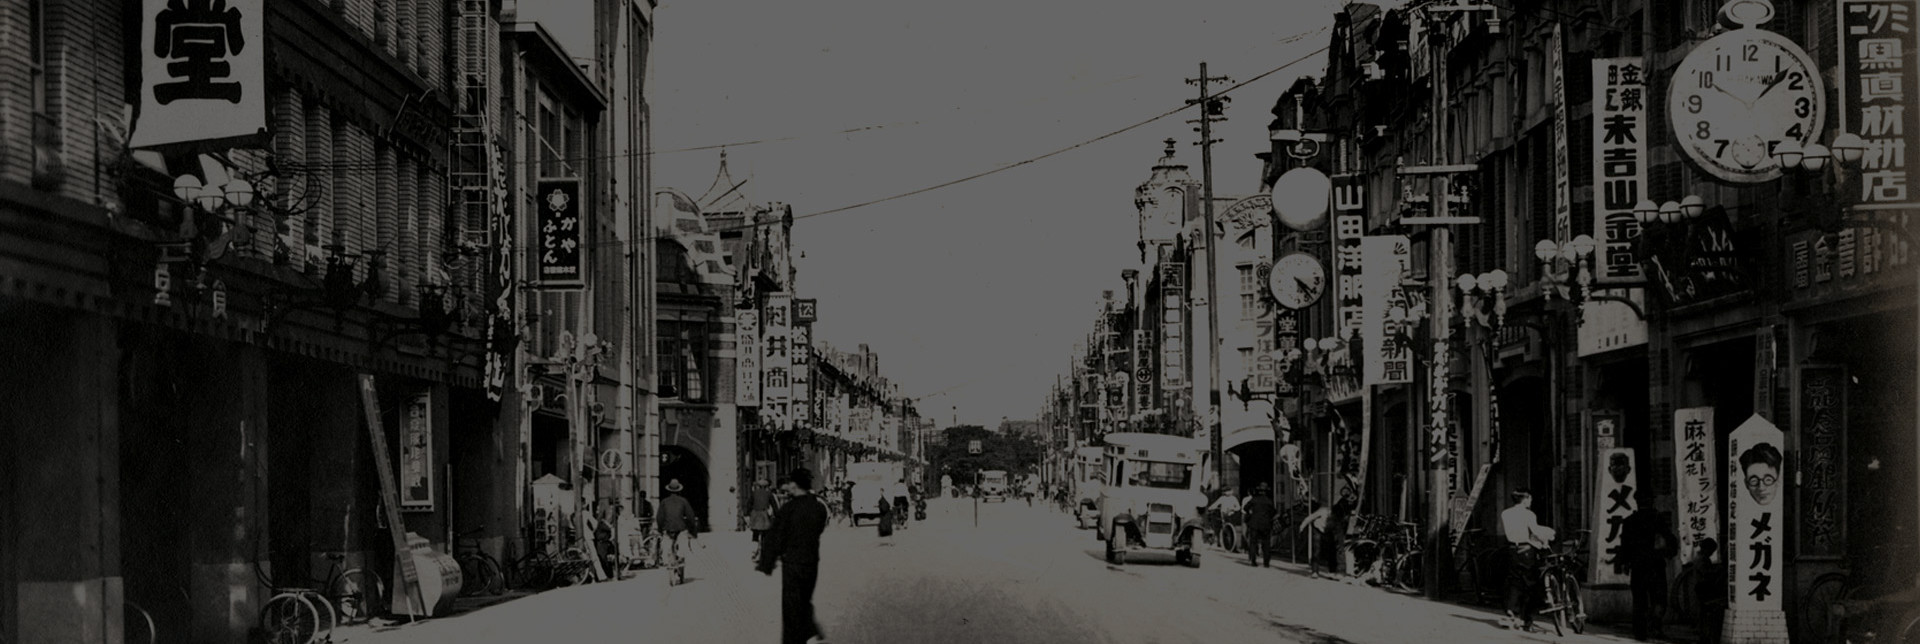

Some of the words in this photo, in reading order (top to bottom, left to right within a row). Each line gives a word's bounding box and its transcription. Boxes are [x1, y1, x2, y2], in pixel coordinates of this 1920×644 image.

[154, 0, 244, 105] 堂
[1743, 44, 1758, 61] 12
[1716, 54, 1731, 71] 11
[1775, 55, 1780, 73] 1
[1620, 63, 1642, 112] 金銀
[1699, 71, 1713, 88] 10
[1788, 72, 1804, 90] 2
[1688, 95, 1702, 113] 9
[1794, 97, 1810, 118] 3
[1696, 121, 1710, 139] 8
[1785, 123, 1803, 141] 4
[1714, 140, 1729, 158] 7
[543, 218, 558, 264] ふとん
[560, 216, 577, 254] かや
[1683, 419, 1707, 462] 麻雀
[1748, 512, 1772, 601] メガネ
